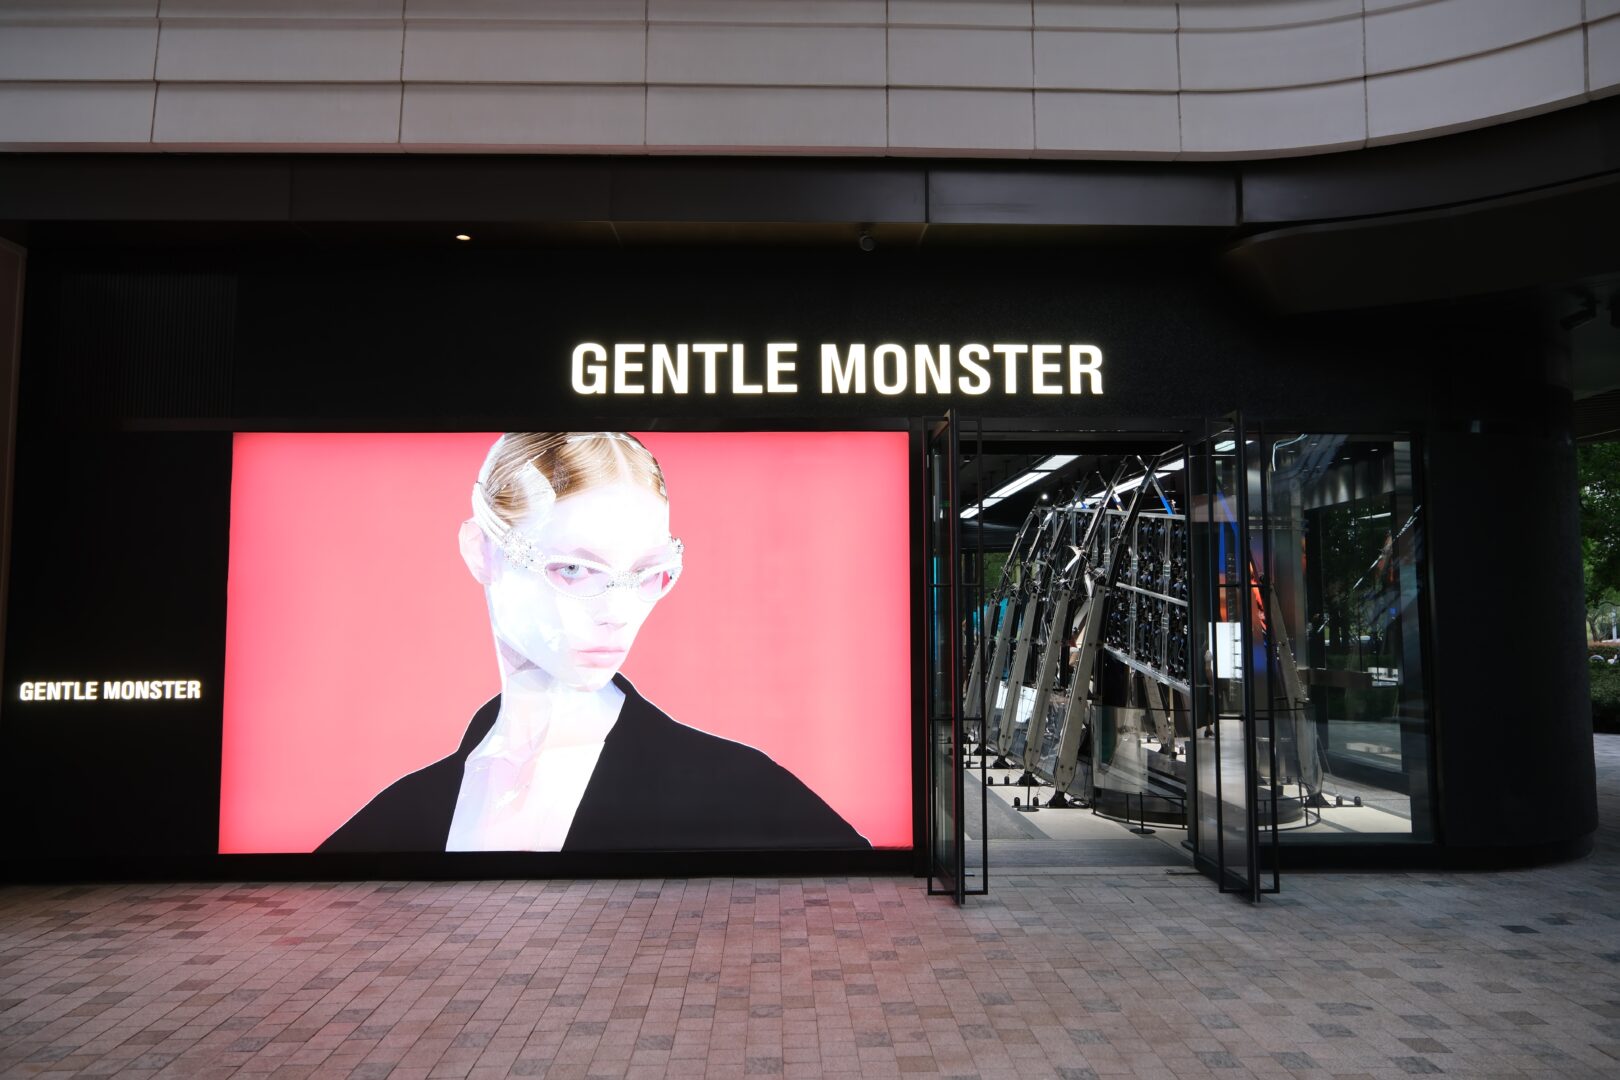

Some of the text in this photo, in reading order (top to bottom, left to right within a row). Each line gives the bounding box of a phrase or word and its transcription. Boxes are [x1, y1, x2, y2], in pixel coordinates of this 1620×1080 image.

[571, 342, 1104, 396] GENTLE MONSTER
[19, 679, 201, 702] GENTLE MONSTER
